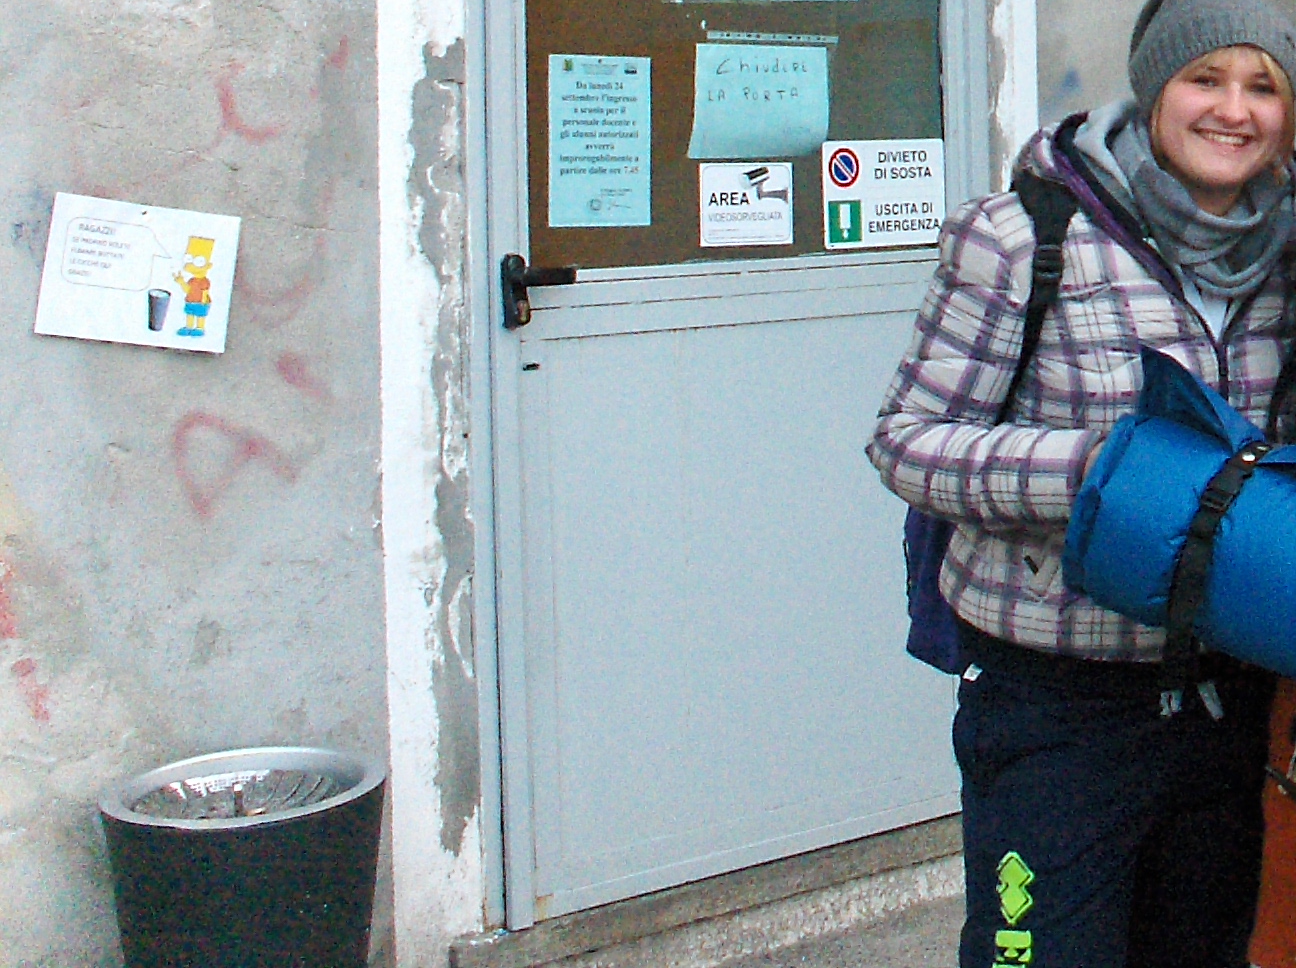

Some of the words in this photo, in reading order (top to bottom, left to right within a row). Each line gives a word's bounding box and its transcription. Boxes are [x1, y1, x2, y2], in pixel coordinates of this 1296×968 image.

[708, 89, 726, 102] LA
[743, 87, 799, 101] PORTA
[562, 119, 599, 127] personale
[878, 150, 927, 163] DIVIETO
[874, 168, 888, 179] DI
[890, 166, 932, 179] SOSTA
[708, 192, 750, 207] AREA
[875, 203, 918, 215] USCITA
[922, 202, 933, 214] DI
[708, 211, 783, 222] VIDEOSORVEGLIATA
[868, 219, 941, 233] EMERGENZA
